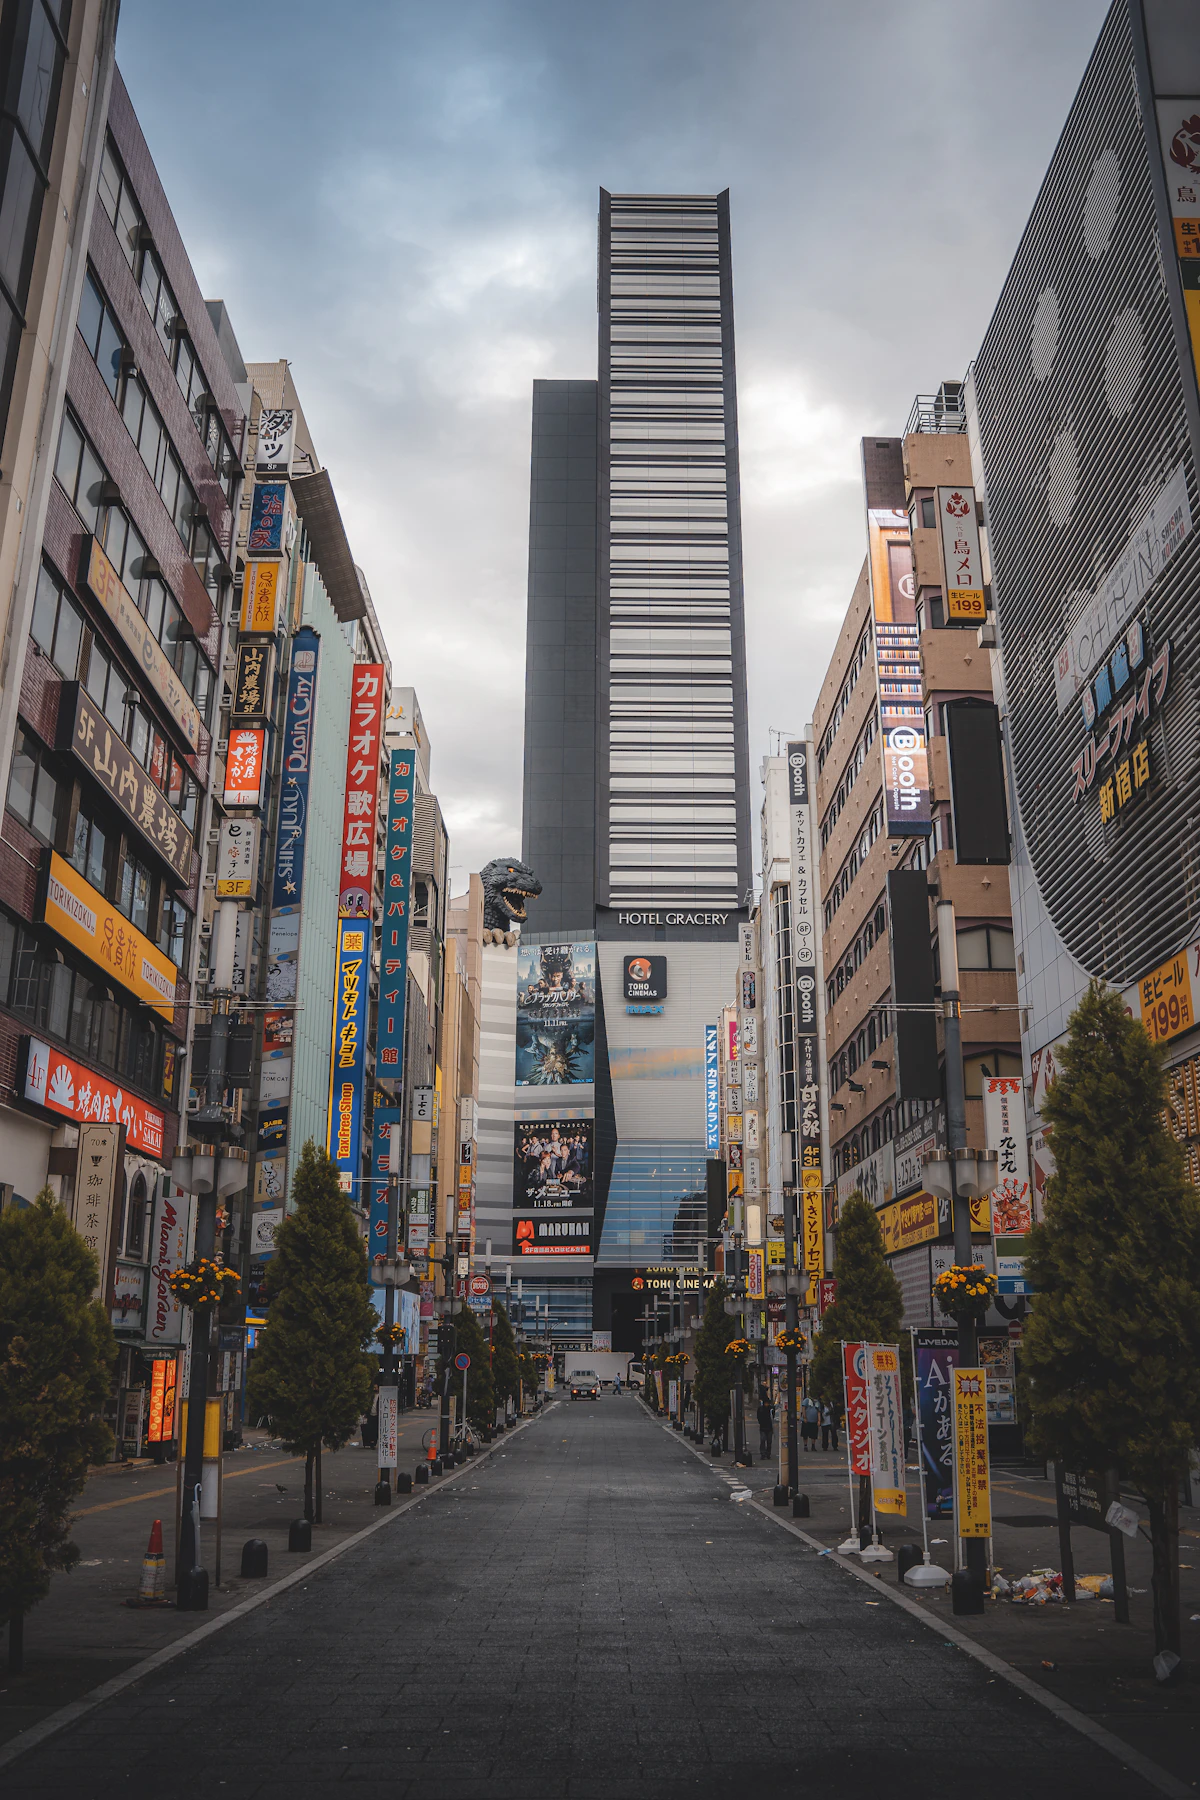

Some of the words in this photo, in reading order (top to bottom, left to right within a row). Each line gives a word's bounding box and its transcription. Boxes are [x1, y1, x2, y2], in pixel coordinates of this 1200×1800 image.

[263, 411, 287, 459] ダーツ
[250, 494, 283, 548] 海の家
[1162, 506, 1183, 544] SHISHA
[1162, 522, 1185, 564] HOOKAH
[953, 540, 972, 586] 鳥メロ
[256, 570, 273, 622] 鳥貴族
[955, 600, 982, 612] 199
[240, 648, 264, 704] 山内農場
[244, 704, 254, 712] 5F
[78, 708, 96, 748] 5F
[242, 744, 260, 780] 焼肉屋
[344, 672, 378, 878] カラオケ歌広場
[789, 752, 806, 796] Booth
[889, 726, 921, 811] Booth
[94, 730, 178, 862] 山内農場
[233, 792, 250, 804] 4F
[1099, 740, 1150, 825] 新宿店
[279, 789, 302, 878] SHINJUKU
[796, 810, 806, 860] ネットカフェ
[226, 882, 244, 893] 3F
[798, 866, 806, 874] &
[798, 879, 808, 914] カプセル
[618, 913, 664, 925] HOTEL
[666, 913, 728, 925] GRACERY
[345, 933, 362, 950] 薬
[797, 976, 815, 1023] Booth
[1144, 960, 1184, 1008] 生ビール
[626, 1005, 664, 1014] IMAX
[28, 1053, 45, 1090] 4F
[1032, 1055, 1040, 1073] 6F
[340, 1082, 354, 1112] Shop
[418, 1094, 428, 1117] TFC
[800, 1083, 820, 1139] 甘太郎
[1000, 1097, 1010, 1134] 個室居酒屋
[142, 1127, 162, 1148] SAKAI
[338, 1112, 352, 1137] Free
[336, 1138, 351, 1160] Tax
[804, 1146, 820, 1156] 4F
[804, 1156, 820, 1166] 3F
[1000, 1136, 1018, 1174] 九十九
[538, 1222, 590, 1236] MARUHAN
[939, 1199, 949, 1224] 2F
[646, 1280, 674, 1288] TOHO
[851, 1386, 870, 1472] スタジオ
